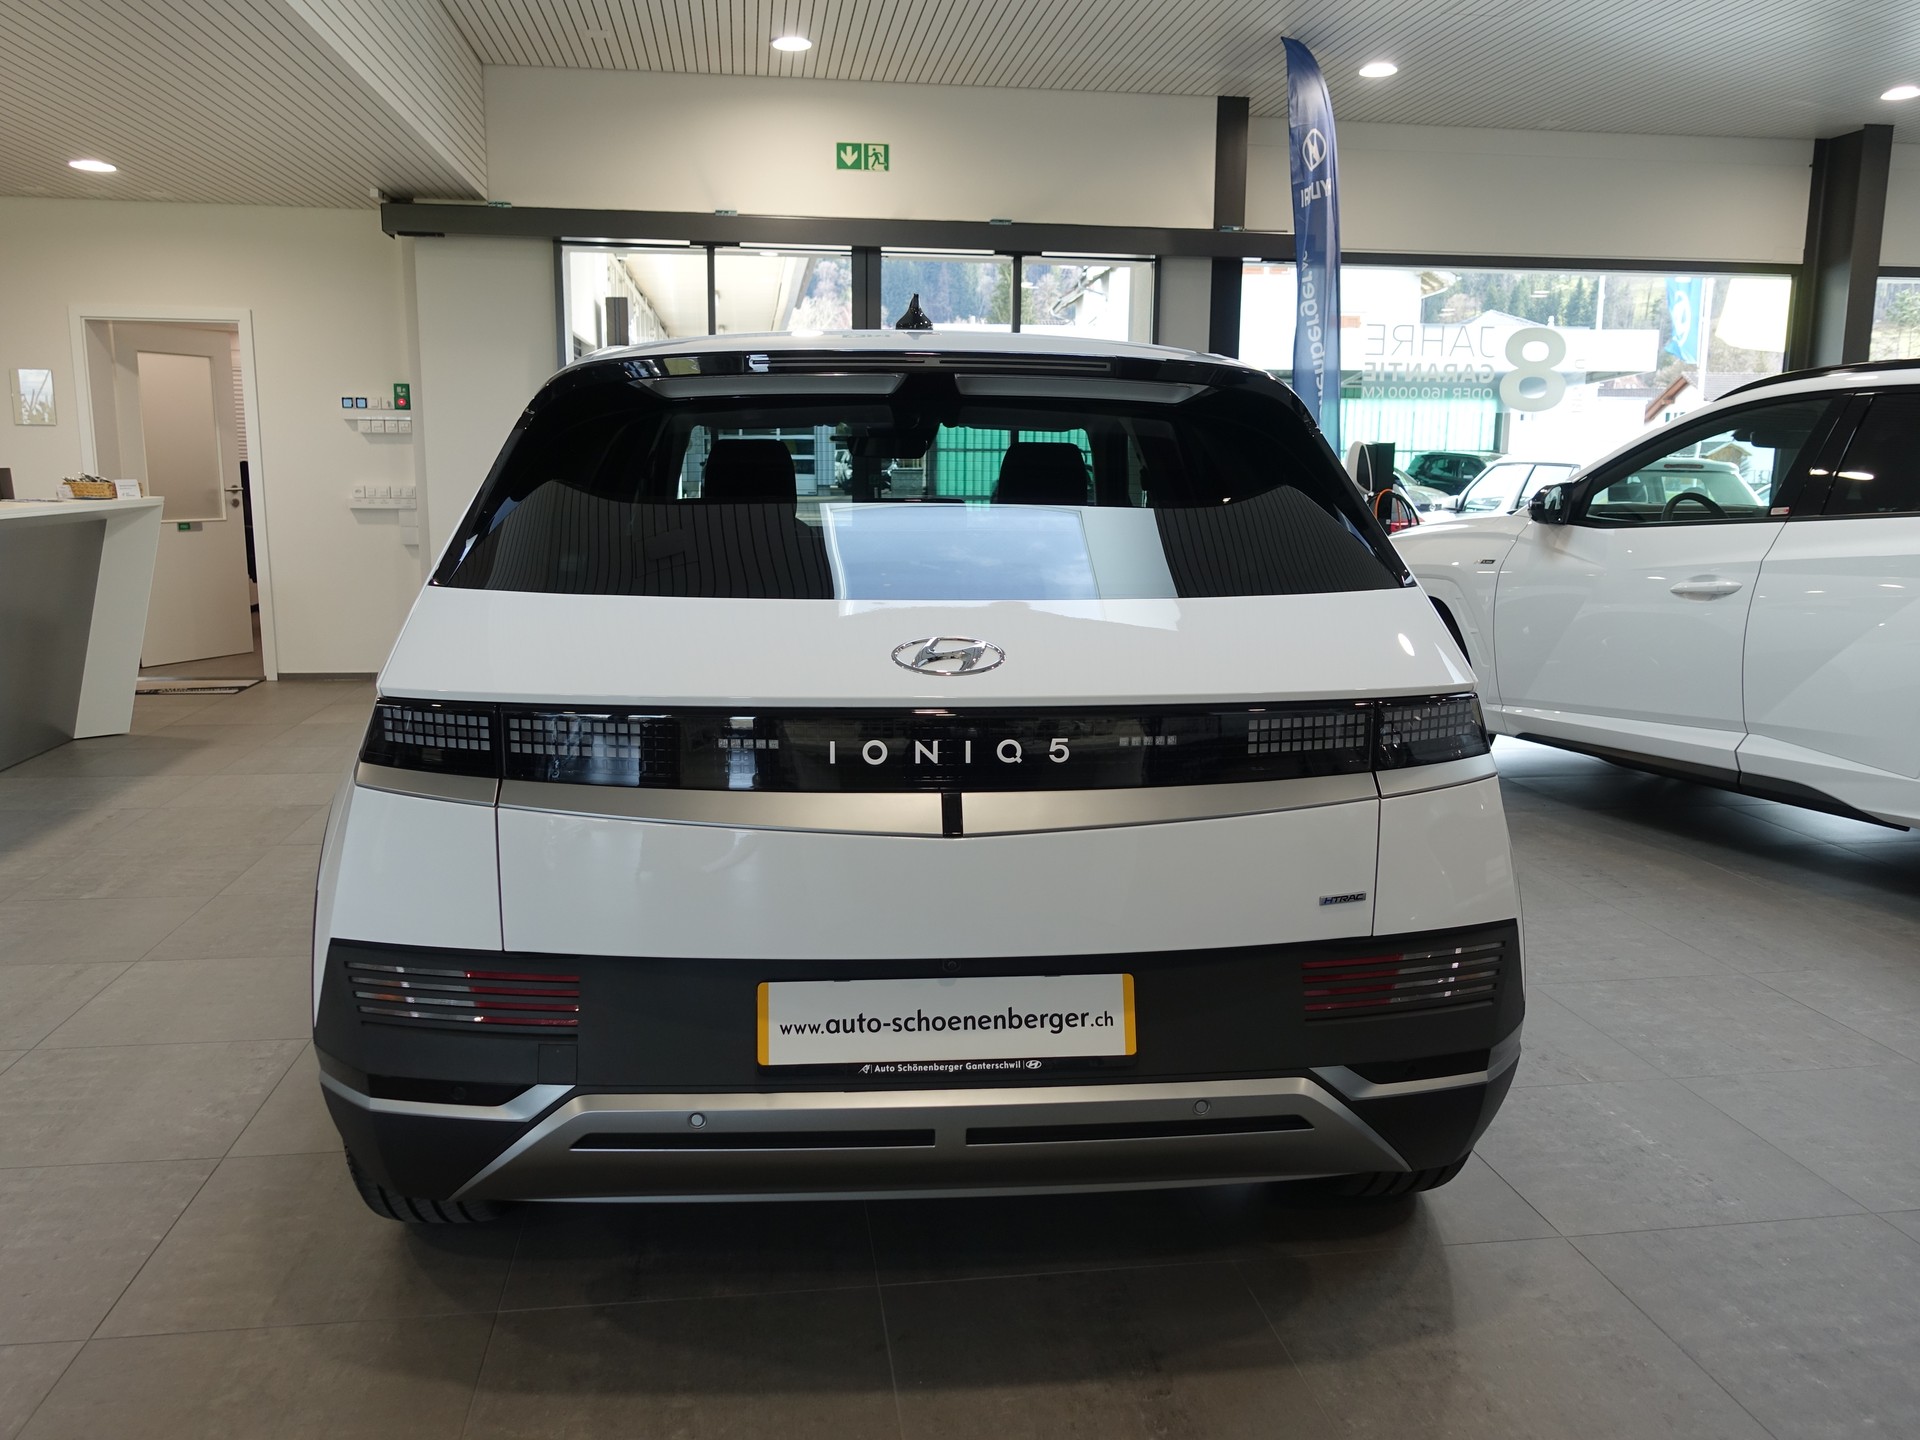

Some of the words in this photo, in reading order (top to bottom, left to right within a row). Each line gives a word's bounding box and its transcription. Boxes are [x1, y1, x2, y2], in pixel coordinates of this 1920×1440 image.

[828, 738, 1023, 766] IONIQ
[1048, 737, 1070, 764] 5
[1322, 892, 1365, 905] HTRAC
[779, 1006, 1114, 1035] www.auto-schoenenberger.ch
[874, 1064, 896, 1073] Auto
[897, 1062, 963, 1073] Schönenberger
[965, 1060, 1021, 1070] Ganterschwil
